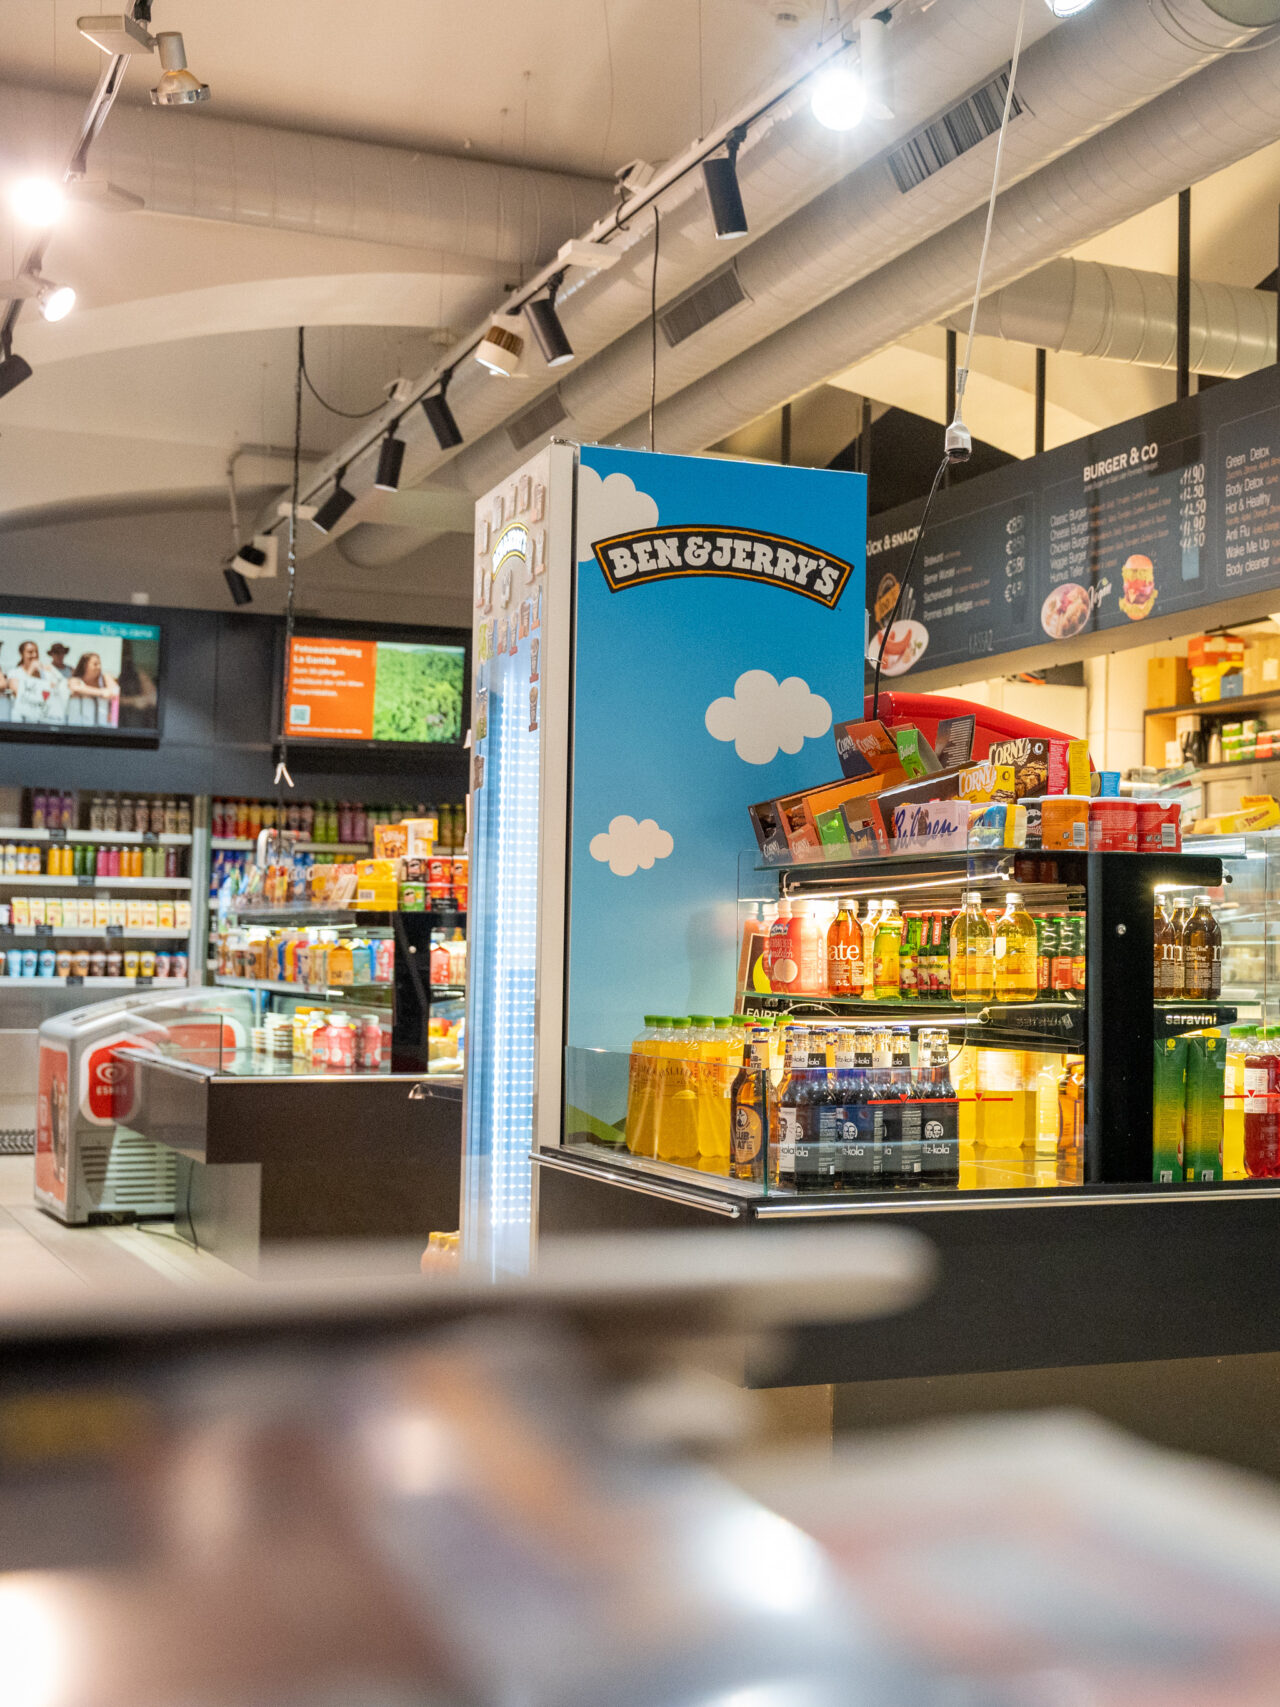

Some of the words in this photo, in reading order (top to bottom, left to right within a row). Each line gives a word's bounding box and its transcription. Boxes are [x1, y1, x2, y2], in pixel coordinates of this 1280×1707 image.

[1083, 452, 1127, 482] BURGER
[1129, 447, 1139, 466] &
[1141, 442, 1158, 461] CO
[1226, 454, 1246, 469] Green
[608, 537, 682, 579] BEN
[686, 536, 711, 567] &
[712, 536, 840, 595] JERRY'S
[989, 737, 1030, 766] CORNY
[958, 766, 997, 797] CORNY
[1165, 1013, 1217, 1025] saravini
